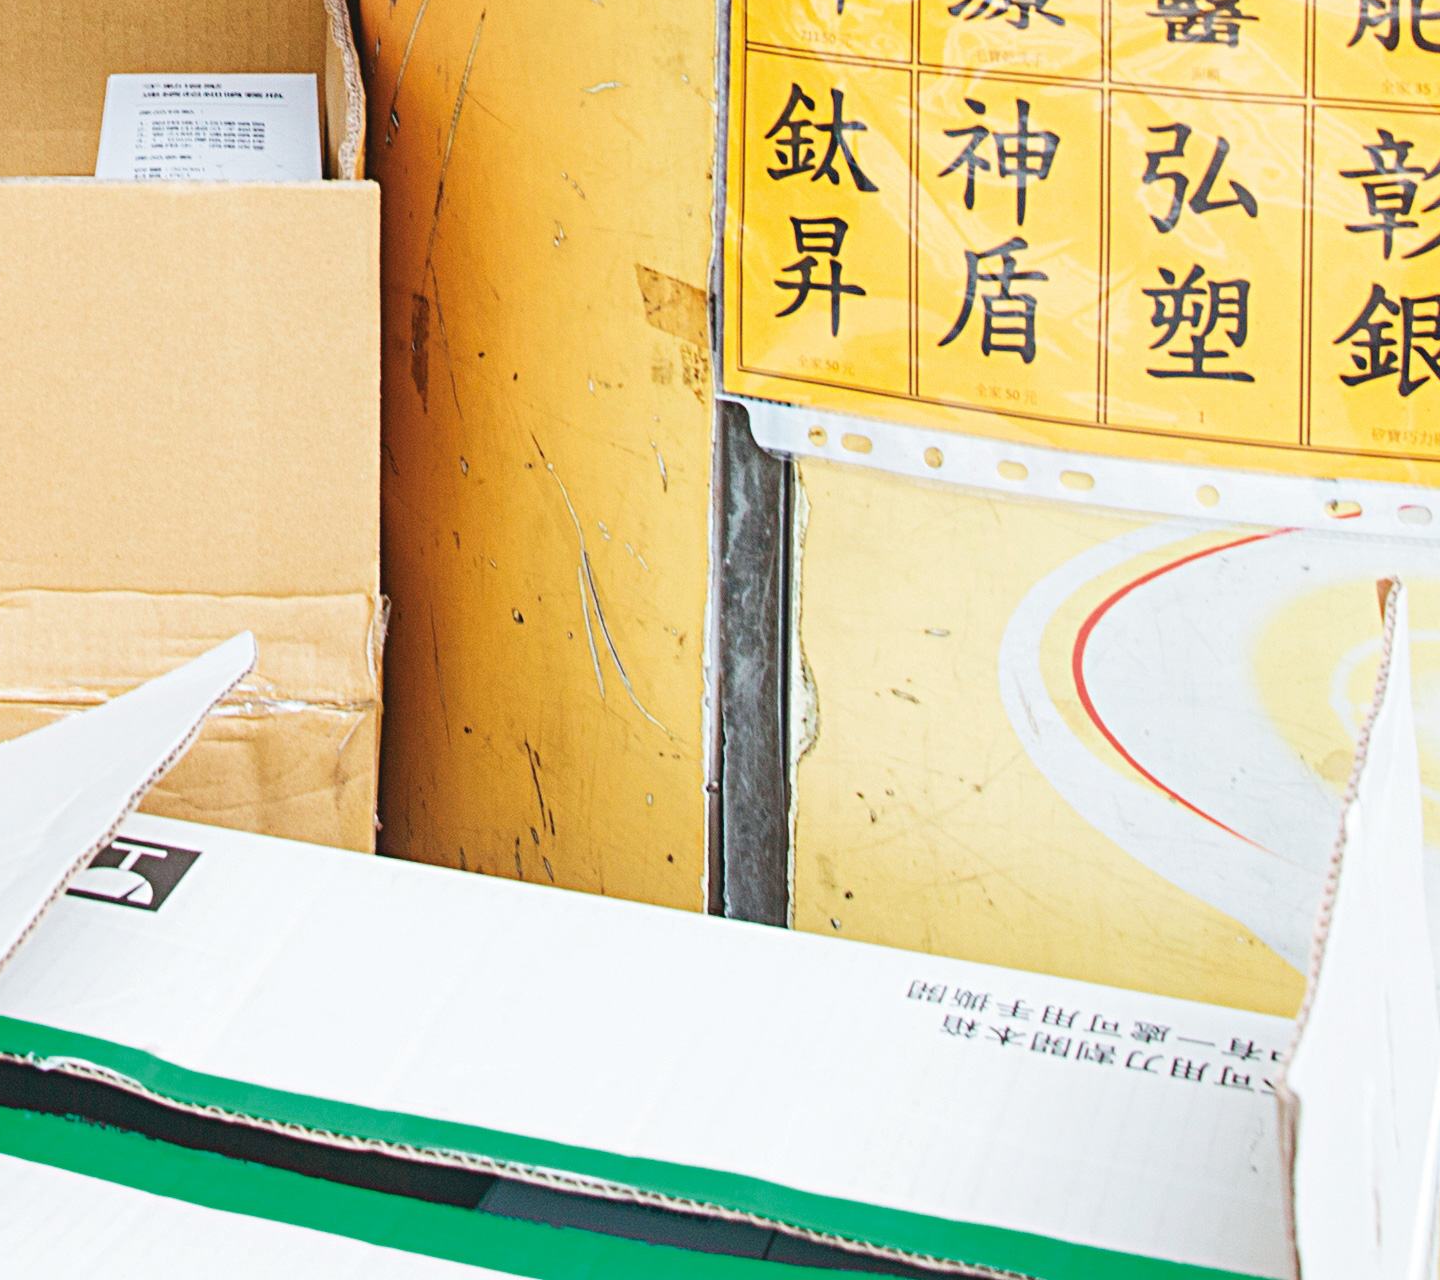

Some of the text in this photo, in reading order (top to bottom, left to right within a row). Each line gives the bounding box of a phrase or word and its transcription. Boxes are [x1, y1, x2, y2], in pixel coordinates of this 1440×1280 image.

[763, 81, 880, 338] 鈦昇
[938, 98, 1061, 364] 神盾
[1142, 123, 1260, 384] 弘塑
